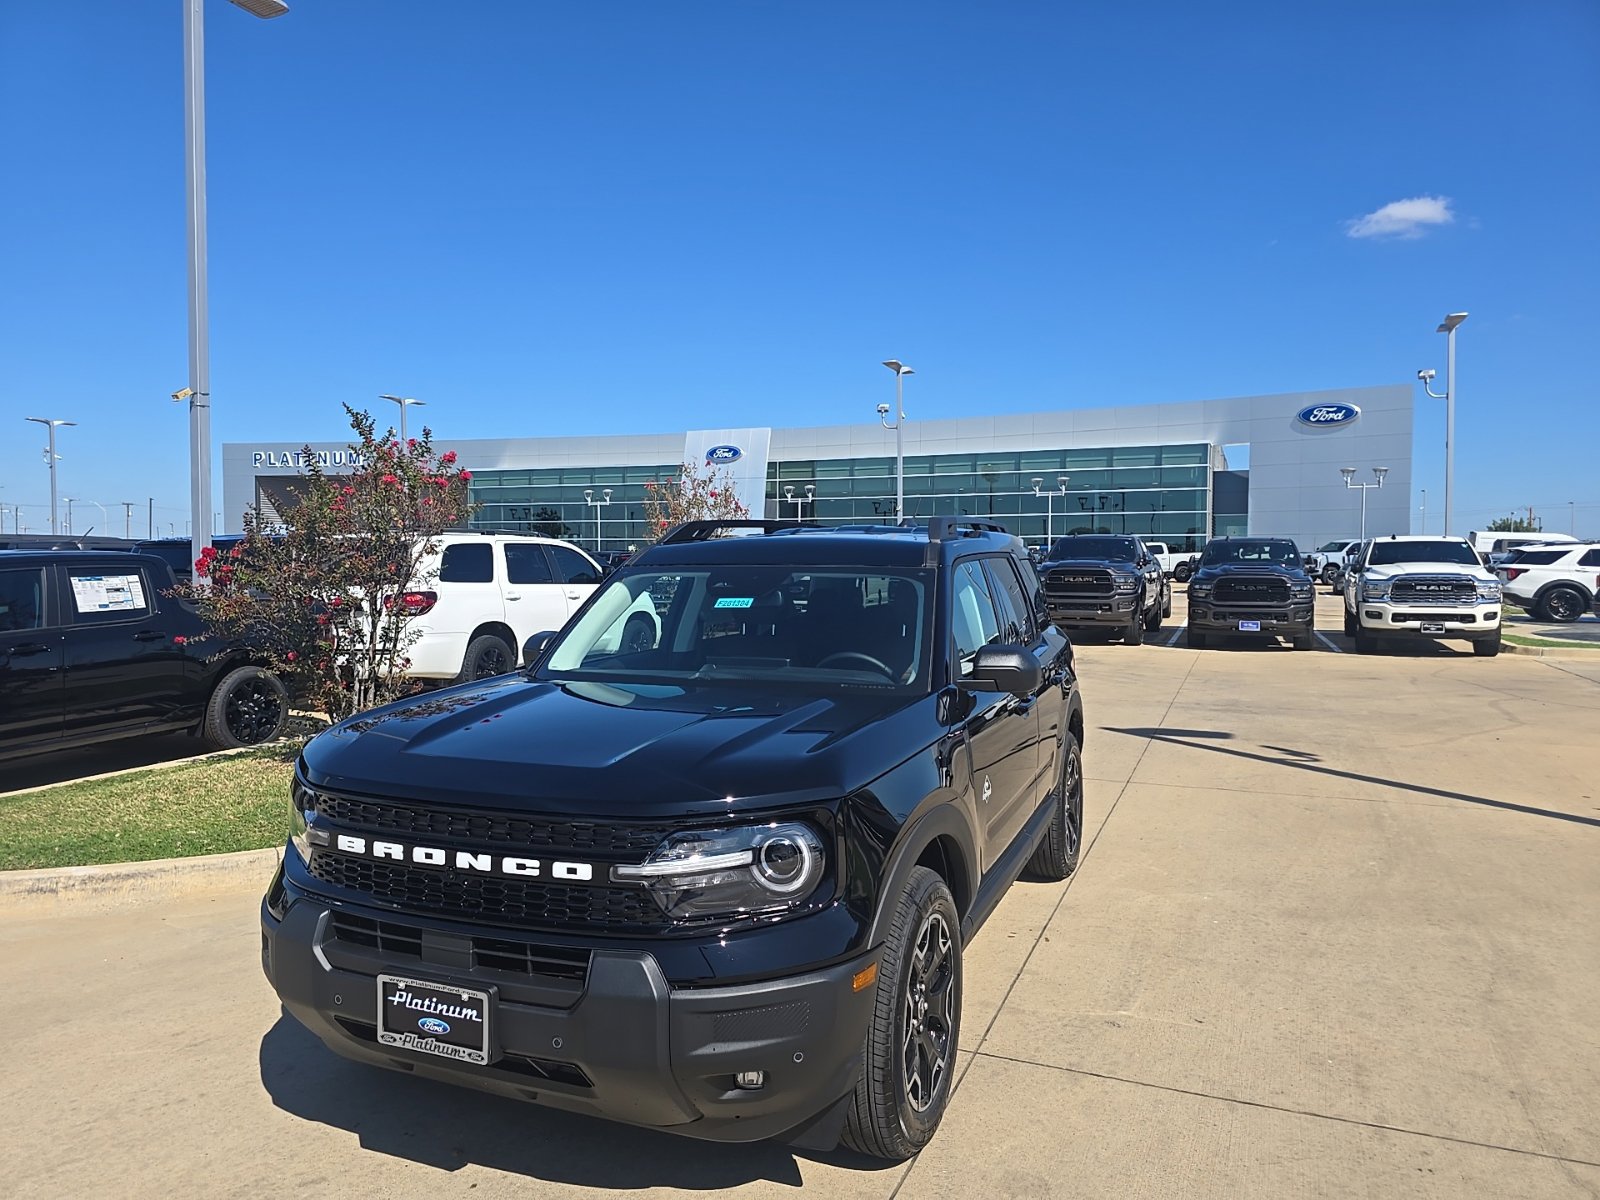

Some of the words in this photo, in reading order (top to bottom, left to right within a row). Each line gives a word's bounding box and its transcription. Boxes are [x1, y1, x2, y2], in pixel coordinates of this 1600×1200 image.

[1309, 407, 1346, 422] Ford
[253, 451, 363, 467] PLATNUM
[713, 448, 734, 458] Ford
[337, 834, 593, 882] BRONCO
[387, 990, 483, 1022] Platinum
[423, 1021, 445, 1033] Ford
[402, 1033, 466, 1059] Platinum
